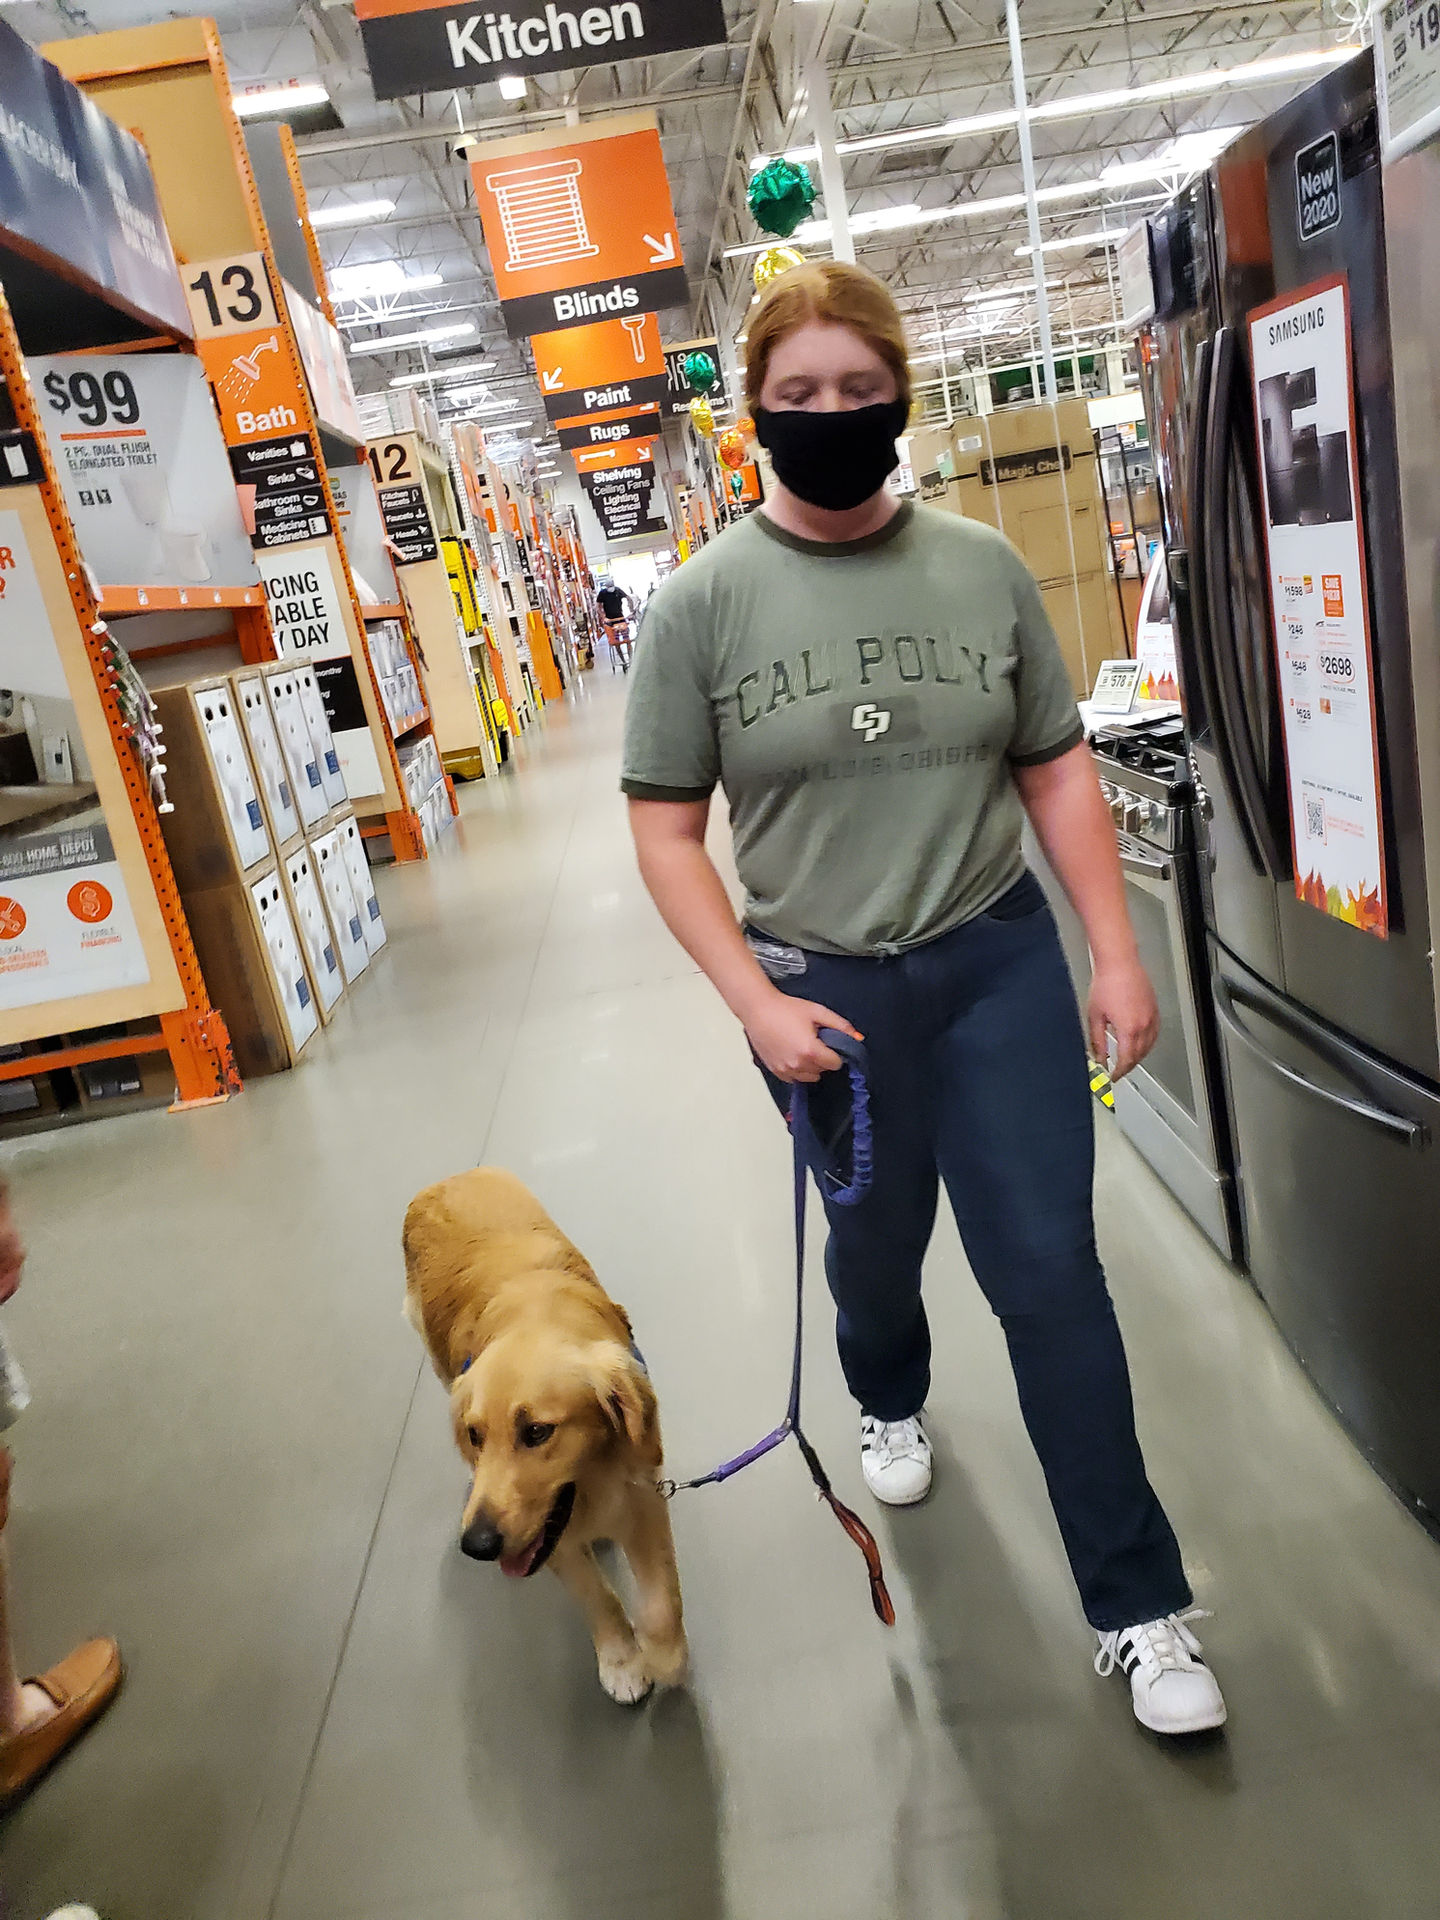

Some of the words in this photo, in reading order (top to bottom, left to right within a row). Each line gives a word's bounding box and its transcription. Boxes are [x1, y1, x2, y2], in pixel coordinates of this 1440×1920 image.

[445, 1, 645, 68] Kitchen
[1301, 166, 1335, 200] New
[1303, 192, 1337, 229] 2020
[190, 264, 262, 327] 13
[553, 284, 640, 321] Blinds
[1269, 306, 1325, 346] SAMSUNG
[43, 370, 140, 427] $99
[583, 386, 632, 409] Paint
[235, 405, 297, 435] Bath
[590, 422, 631, 440] Rugs
[126, 454, 158, 466] TOILET
[247, 447, 289, 462] Vanities
[368, 443, 412, 483] 12
[267, 472, 297, 486] Sinks
[592, 467, 642, 483] Shelving
[997, 464, 1035, 479] Magic
[1037, 460, 1063, 473] Che
[592, 483, 625, 496] Ceiling
[626, 479, 651, 490] Fans
[253, 494, 301, 510] athroom
[274, 504, 303, 517] Sinks
[603, 493, 639, 506] Lighting
[603, 502, 642, 515] Electrical
[260, 519, 308, 535] Medicine
[264, 529, 310, 545] Cabinets
[607, 526, 633, 537] Garden
[274, 597, 327, 626] ABLE
[291, 622, 330, 650] DAY
[1320, 656, 1352, 677] $2698
[737, 649, 832, 731] CAL
[856, 635, 991, 695] POLY
[850, 703, 891, 743] CP
[27, 845, 59, 862] HOME
[61, 838, 95, 856] DEPOT
